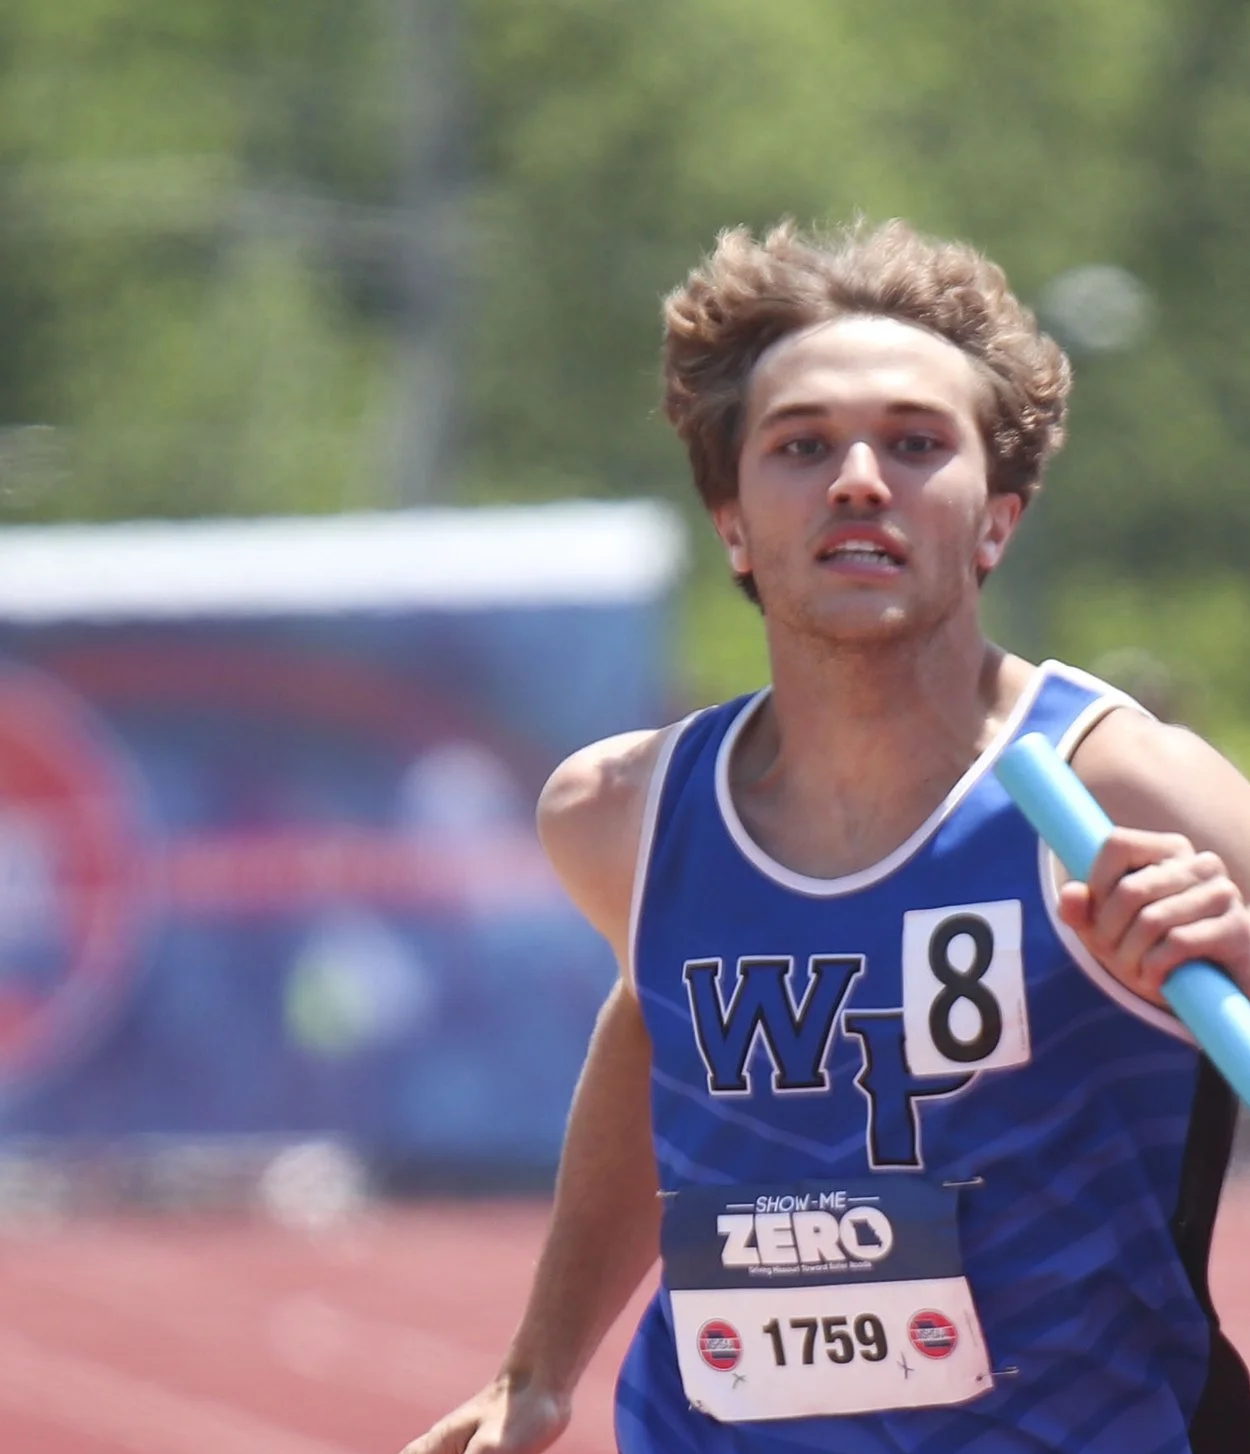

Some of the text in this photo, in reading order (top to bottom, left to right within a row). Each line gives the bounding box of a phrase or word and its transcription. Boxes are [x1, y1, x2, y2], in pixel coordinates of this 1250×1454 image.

[928, 911, 1003, 1063] 8
[756, 1191, 847, 1213] SHOW-ME
[717, 1206, 893, 1267] ZERO
[762, 1313, 889, 1366] 1759
